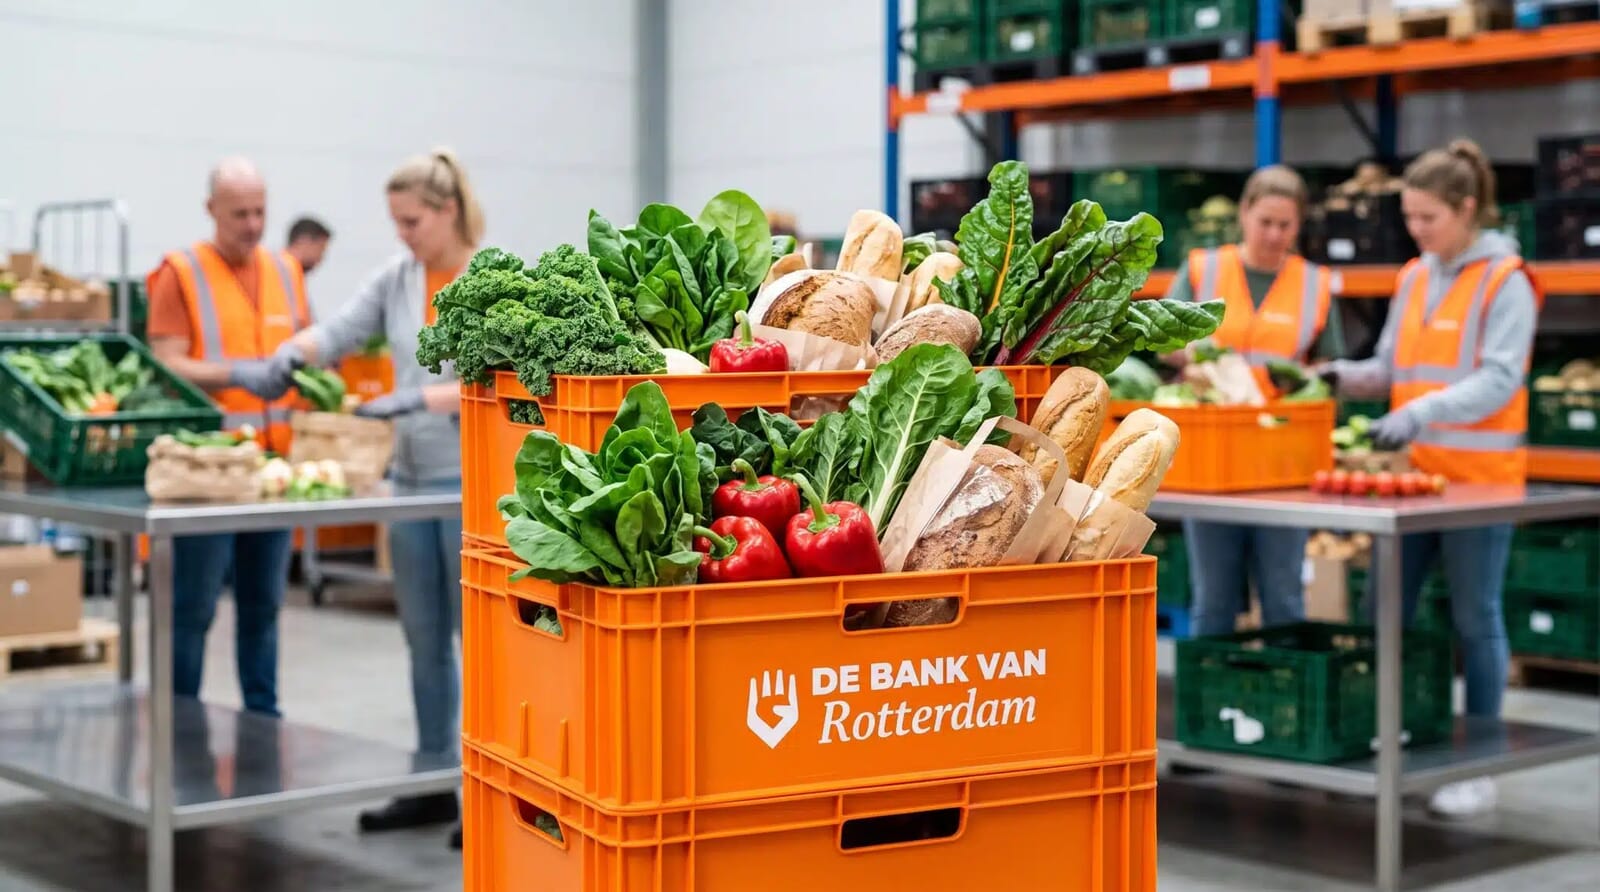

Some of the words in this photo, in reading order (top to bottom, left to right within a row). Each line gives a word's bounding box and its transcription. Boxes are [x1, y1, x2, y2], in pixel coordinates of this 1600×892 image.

[811, 664, 860, 696] DE
[870, 655, 969, 691] BANK
[976, 648, 1047, 680] VAN
[818, 687, 1036, 744] Rotterdam
